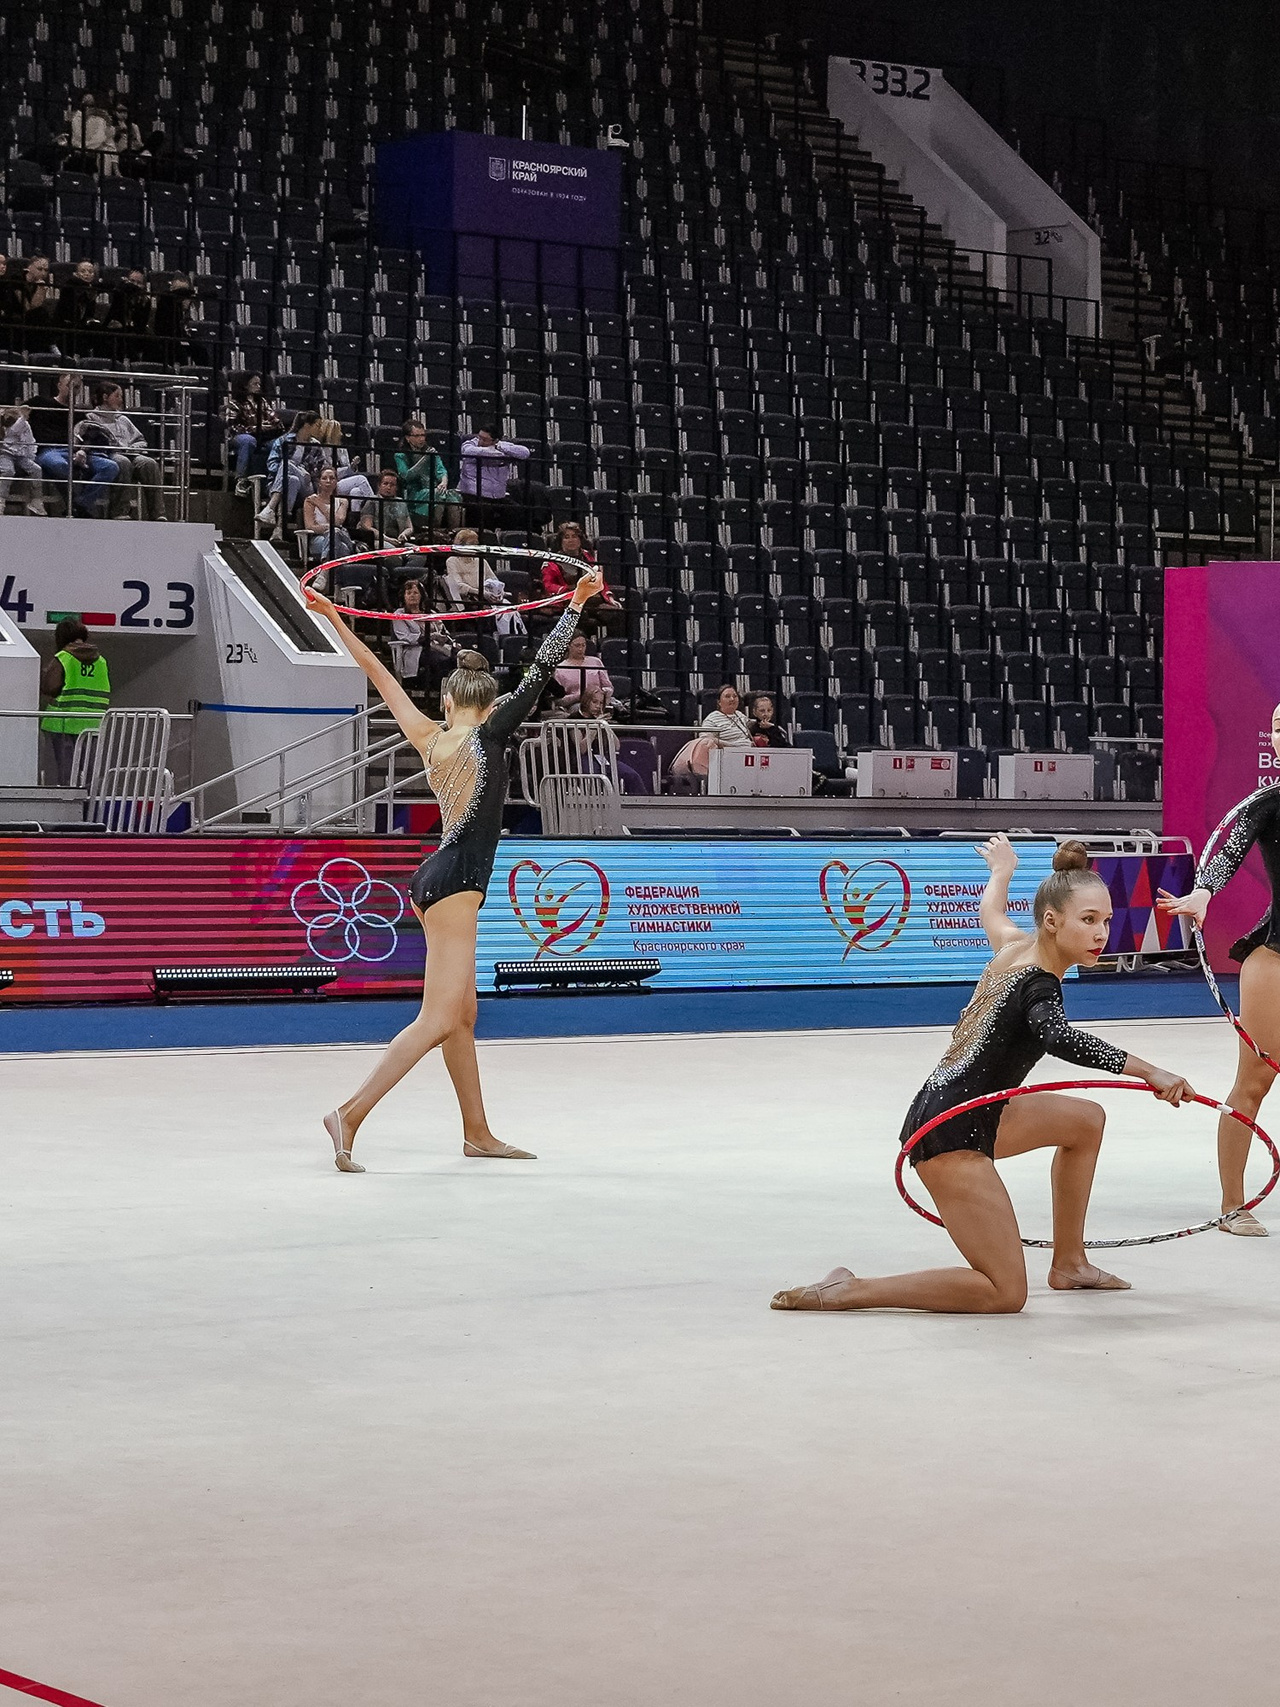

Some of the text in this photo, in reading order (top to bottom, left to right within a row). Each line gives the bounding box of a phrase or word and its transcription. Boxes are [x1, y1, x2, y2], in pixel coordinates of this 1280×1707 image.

[512, 160, 588, 178] КРАСНОЯРСКИЙ
[512, 171, 538, 182] КРАЙ
[120, 580, 195, 629] 2.3
[80, 662, 96, 678] 82
[624, 885, 700, 900] ФЕДЕРАЦИЯ
[923, 884, 988, 898] ФЕДЕРАЦИ
[627, 900, 741, 917] ХУДОЖЕСТВЕННОЙ
[926, 897, 1030, 914] ХУДОЖЕСНОЙ
[0, 900, 106, 938] СТЬ
[629, 920, 713, 933] ГИМНАСТИКИ
[929, 917, 981, 930] ГИМНАСТ
[632, 940, 746, 955] Красноярского края
[931, 935, 990, 950] Красноярс
